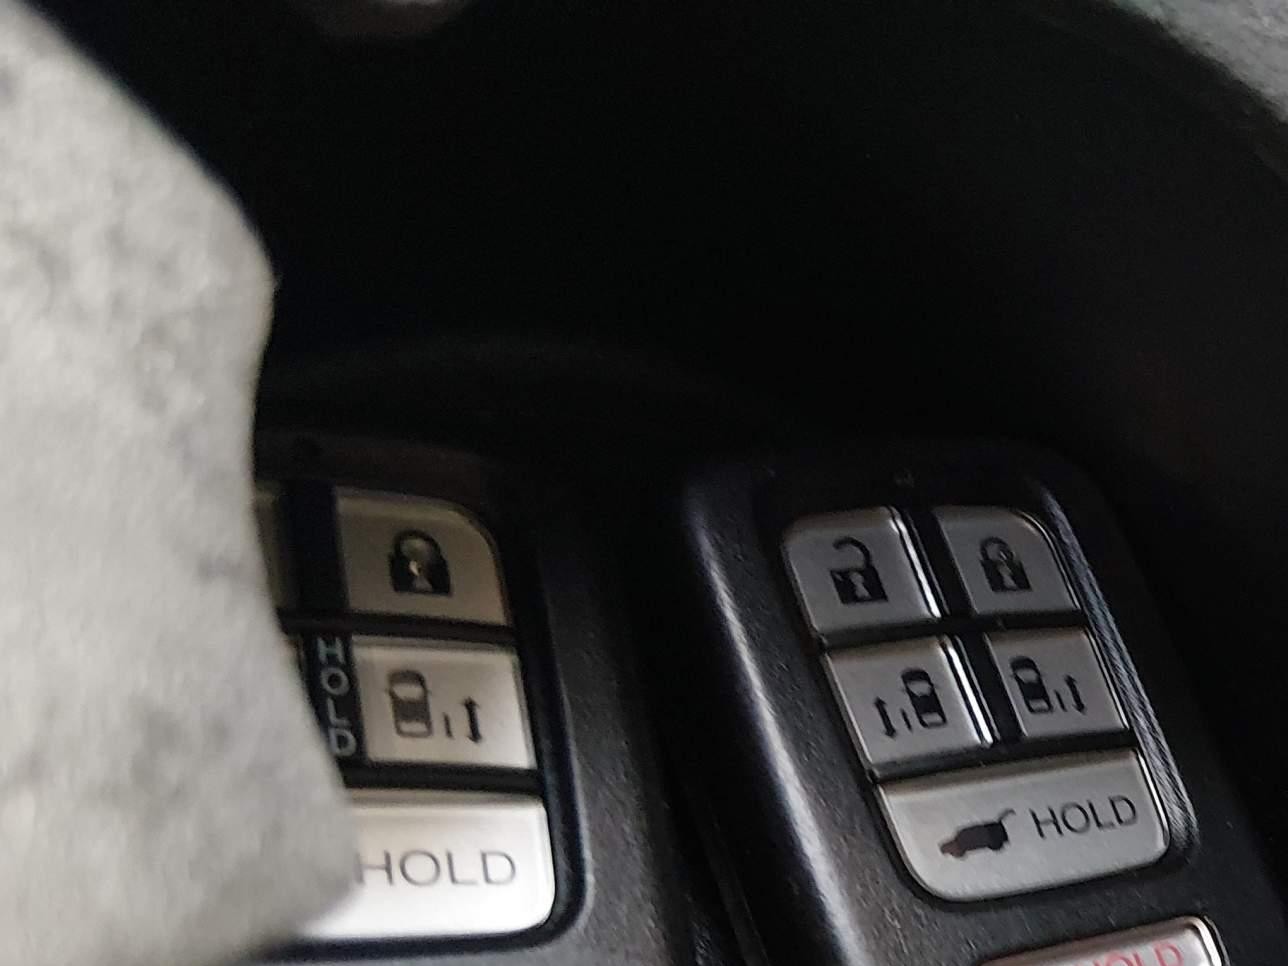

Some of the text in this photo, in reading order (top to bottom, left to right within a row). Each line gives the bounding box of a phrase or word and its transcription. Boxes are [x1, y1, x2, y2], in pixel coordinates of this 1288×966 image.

[317, 638, 357, 758] HOLD
[1030, 795, 1138, 840] HOLD
[358, 849, 517, 887] HOLD
